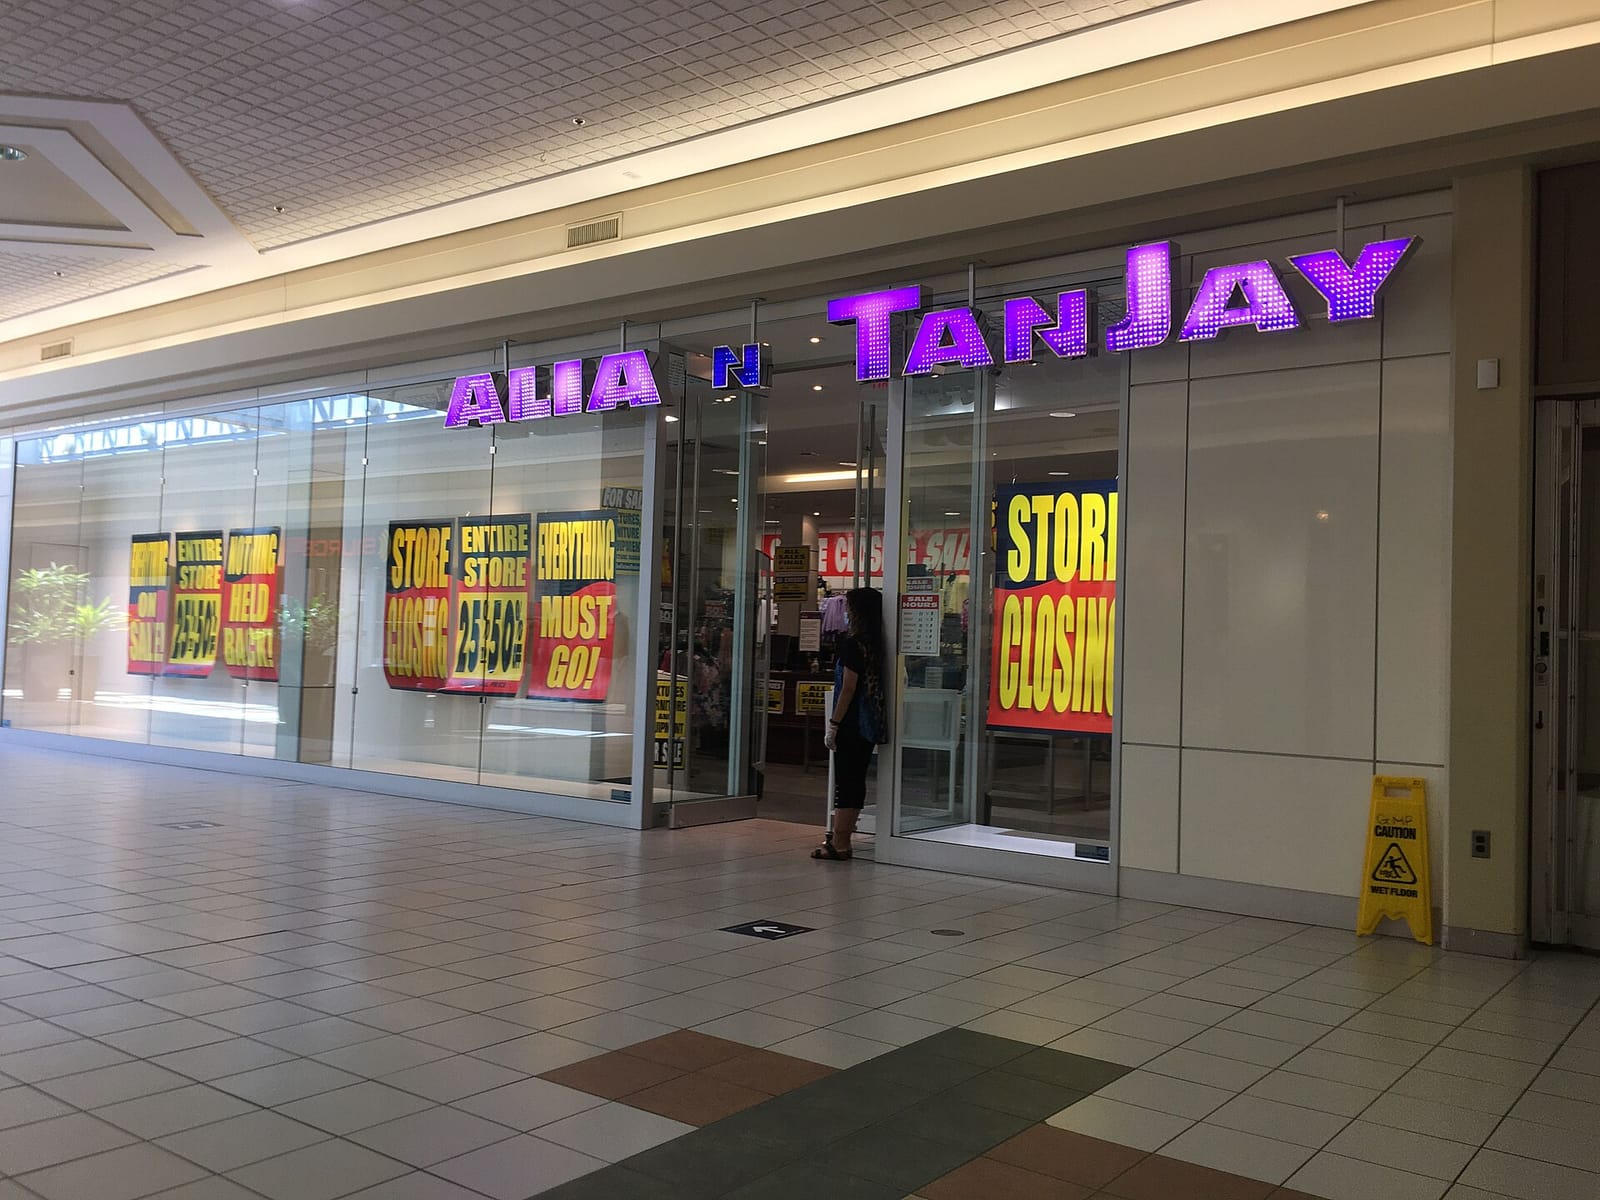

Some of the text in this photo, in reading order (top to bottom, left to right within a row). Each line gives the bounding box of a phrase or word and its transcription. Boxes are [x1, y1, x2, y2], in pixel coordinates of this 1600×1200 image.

[443, 349, 662, 429] ALIA
[603, 488, 643, 509] FOR SAL
[178, 538, 223, 561] ENTIRE
[227, 534, 278, 575] NOTHING
[462, 524, 529, 553] ENTIRE
[538, 519, 615, 580] EVERYTHING
[180, 565, 221, 589] STORE
[391, 527, 452, 589] STORE
[464, 556, 526, 587] STORE
[138, 592, 157, 617] ON
[229, 584, 270, 622] HELD
[540, 595, 612, 639] MUST
[223, 628, 274, 668] BACK!
[387, 597, 449, 678] CLOSING
[547, 645, 601, 690] GO!
[1375, 825, 1416, 840] CAUTION
[1371, 886, 1418, 898] WET FLOOR
